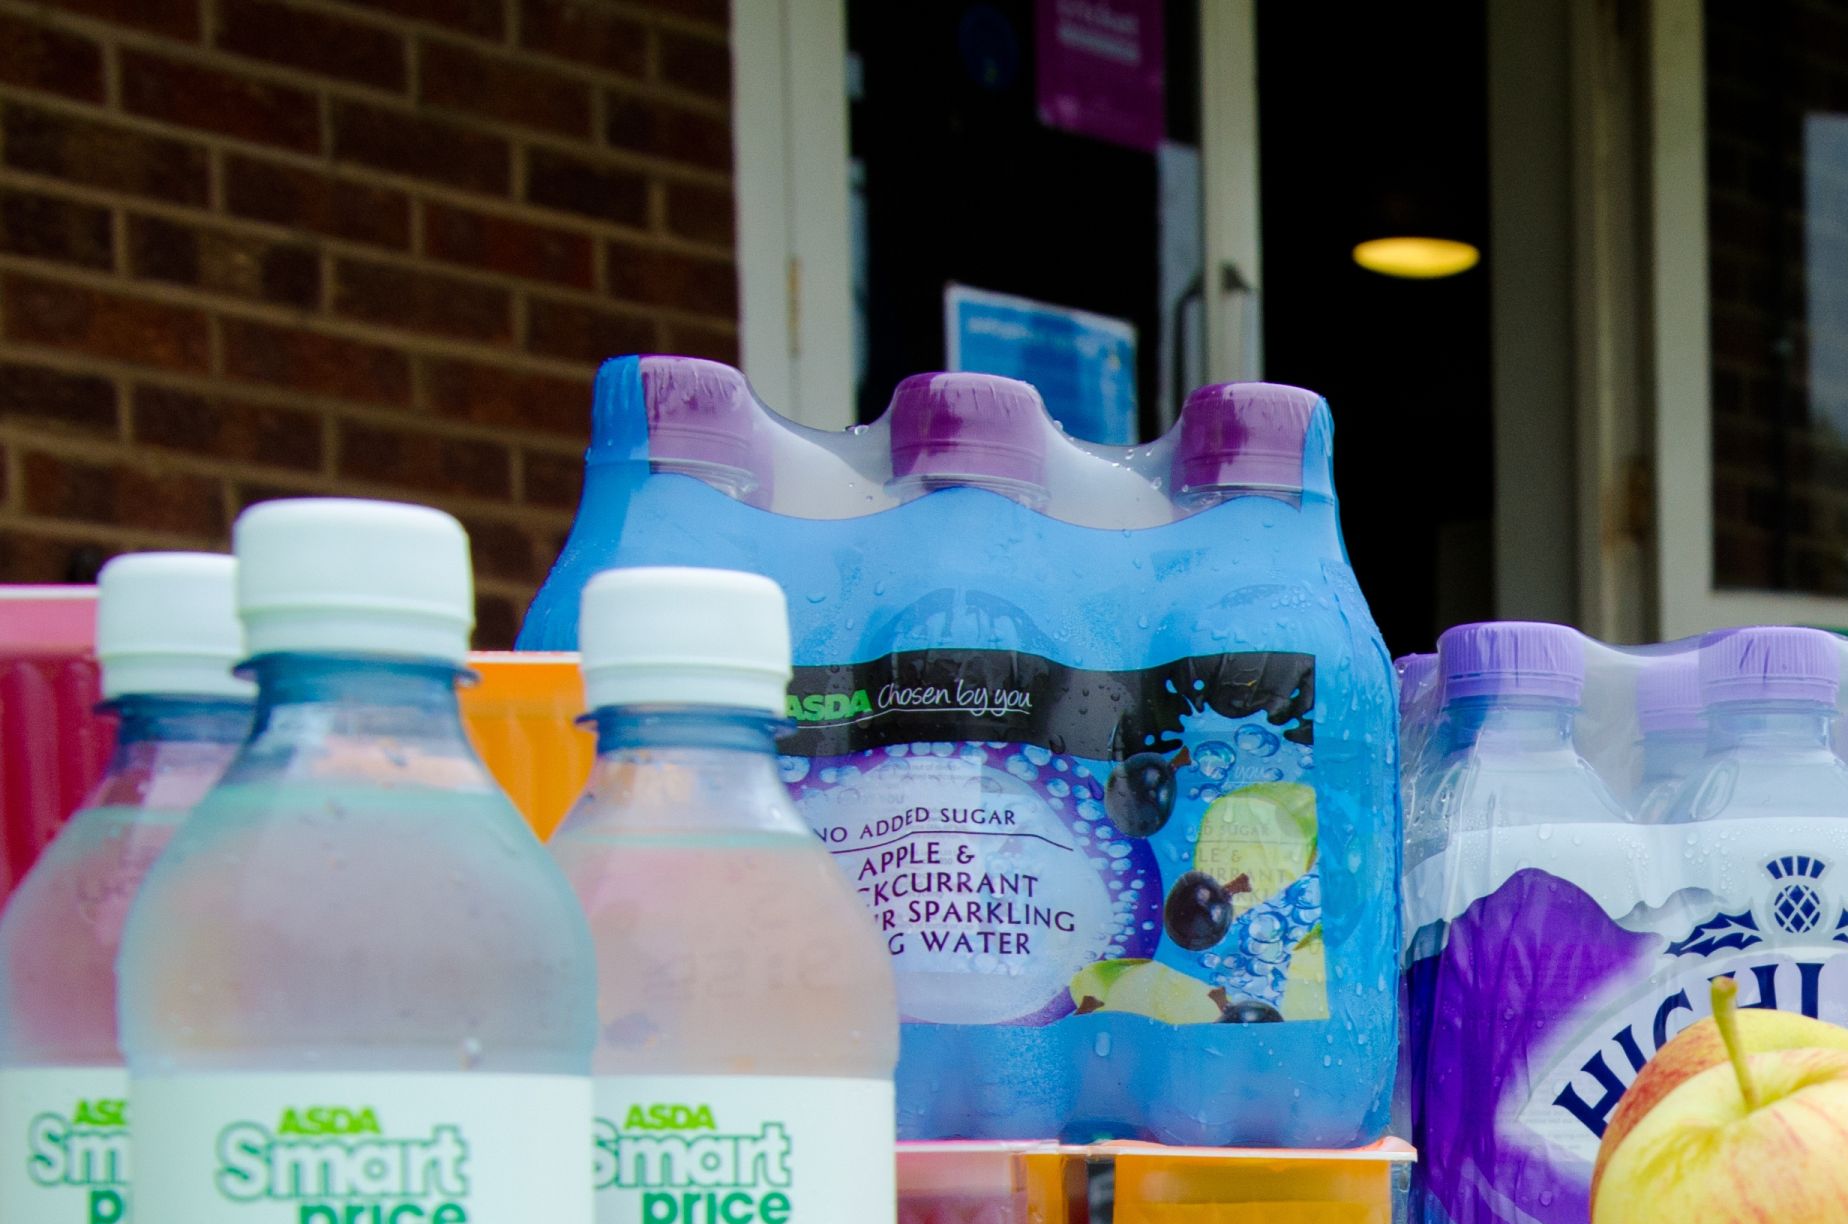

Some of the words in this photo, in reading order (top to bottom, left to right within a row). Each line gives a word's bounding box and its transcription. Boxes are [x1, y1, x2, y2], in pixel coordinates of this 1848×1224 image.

[787, 690, 872, 721] ASDA
[878, 682, 950, 708] Chosen
[955, 680, 989, 716] by
[991, 688, 1033, 716] you
[814, 826, 848, 844] NO
[859, 806, 930, 840] ADDED
[941, 807, 1016, 826] SUGAR
[858, 842, 941, 881] APPLE
[956, 844, 975, 865] &
[857, 872, 1039, 907] KCURRANT
[908, 900, 1075, 932] SPARKLING
[920, 930, 1031, 956] WATER
[74, 1099, 129, 1126] ASD
[278, 1106, 382, 1135] ASDA
[623, 1104, 717, 1131] ASDA
[215, 1120, 469, 1201] Smart
[593, 1117, 792, 1189] Smart
